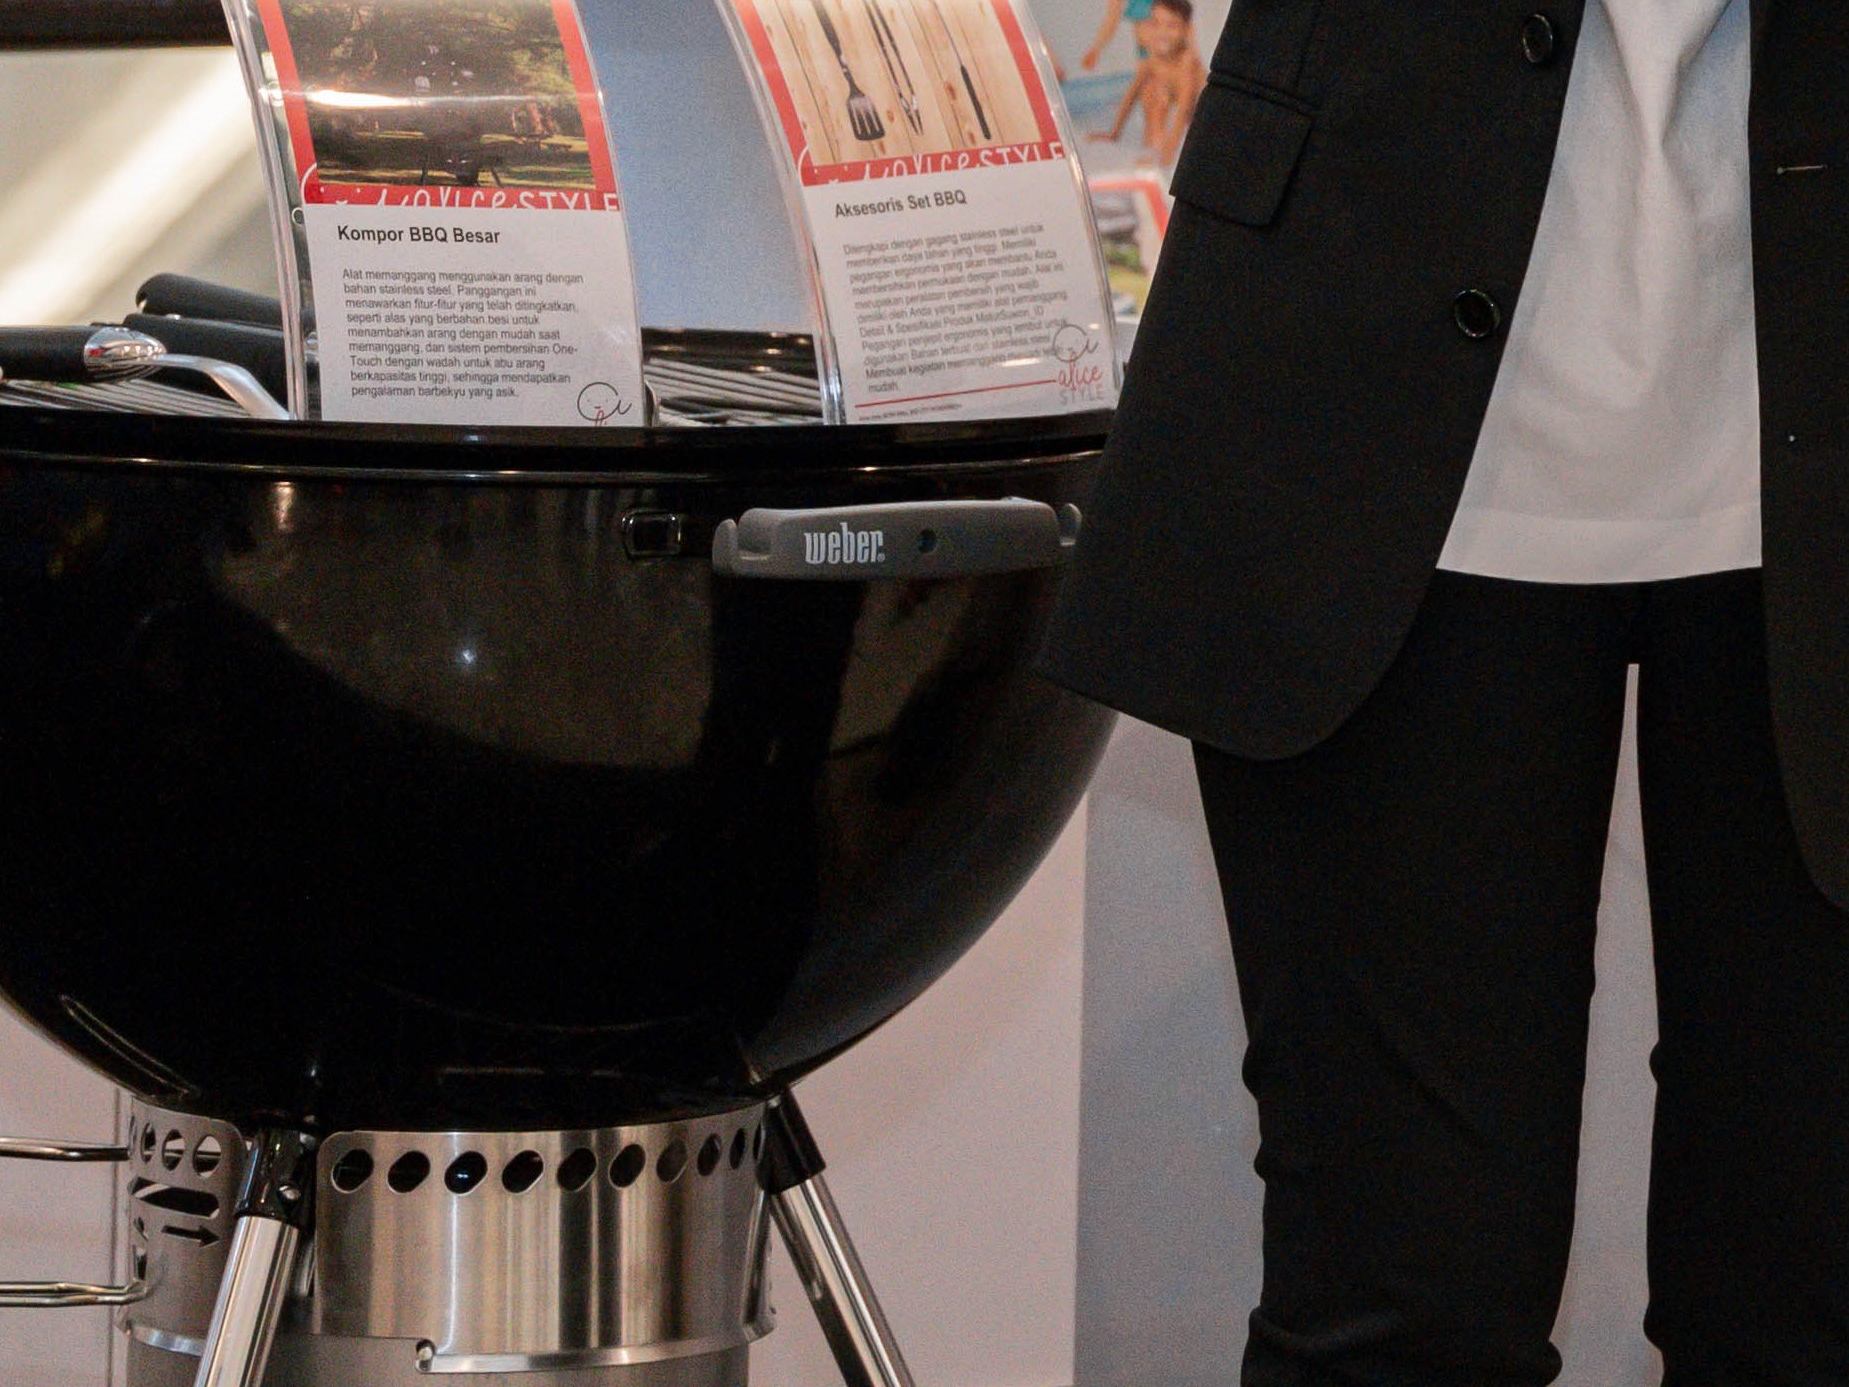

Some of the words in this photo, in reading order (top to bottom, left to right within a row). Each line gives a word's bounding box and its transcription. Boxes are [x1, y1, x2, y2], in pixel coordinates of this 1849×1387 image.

[834, 197, 905, 218] Aksesoris
[908, 194, 931, 210] Set
[934, 190, 968, 207] BBQ
[337, 225, 403, 245] Kompor
[409, 227, 447, 243] BBQ
[453, 228, 500, 244] Besar
[343, 269, 363, 280] Alat
[365, 272, 435, 284] memanggang
[439, 270, 511, 285] menggunakan
[514, 275, 542, 286] arang
[546, 272, 583, 287] dengan
[343, 283, 376, 294] bahan
[379, 283, 424, 295] stainless
[458, 285, 521, 299] Panggangan
[525, 286, 535, 296] ini
[345, 297, 411, 309] menawarkan
[414, 298, 456, 309] fitur-fitur
[459, 302, 484, 313] yang
[488, 299, 512, 310] telah
[347, 312, 381, 326] seperti
[385, 312, 406, 323] alas
[409, 315, 433, 326] yang
[437, 313, 485, 324] berbahan
[488, 313, 509, 324] besi
[512, 313, 539, 324] untuk
[348, 326, 424, 338] menambahkan
[427, 330, 456, 341] arang
[459, 328, 497, 342] dengan
[500, 328, 535, 339] mudah
[539, 328, 560, 339] saat
[426, 342, 444, 353] dan
[448, 342, 480, 353] sistem
[484, 343, 549, 357] pembersihan
[552, 343, 577, 354] One-
[350, 356, 381, 367] Touch
[385, 356, 423, 370] dengan
[426, 356, 460, 367] wadah
[464, 357, 492, 368] untuk
[494, 357, 512, 368] abu
[515, 360, 545, 371] arang
[351, 370, 416, 384] berkapasitas
[453, 371, 499, 385] sehingga
[501, 371, 570, 386] mendapatkan
[352, 385, 415, 399] pengalaman
[418, 385, 465, 399] barbekyu
[468, 389, 493, 400] yang
